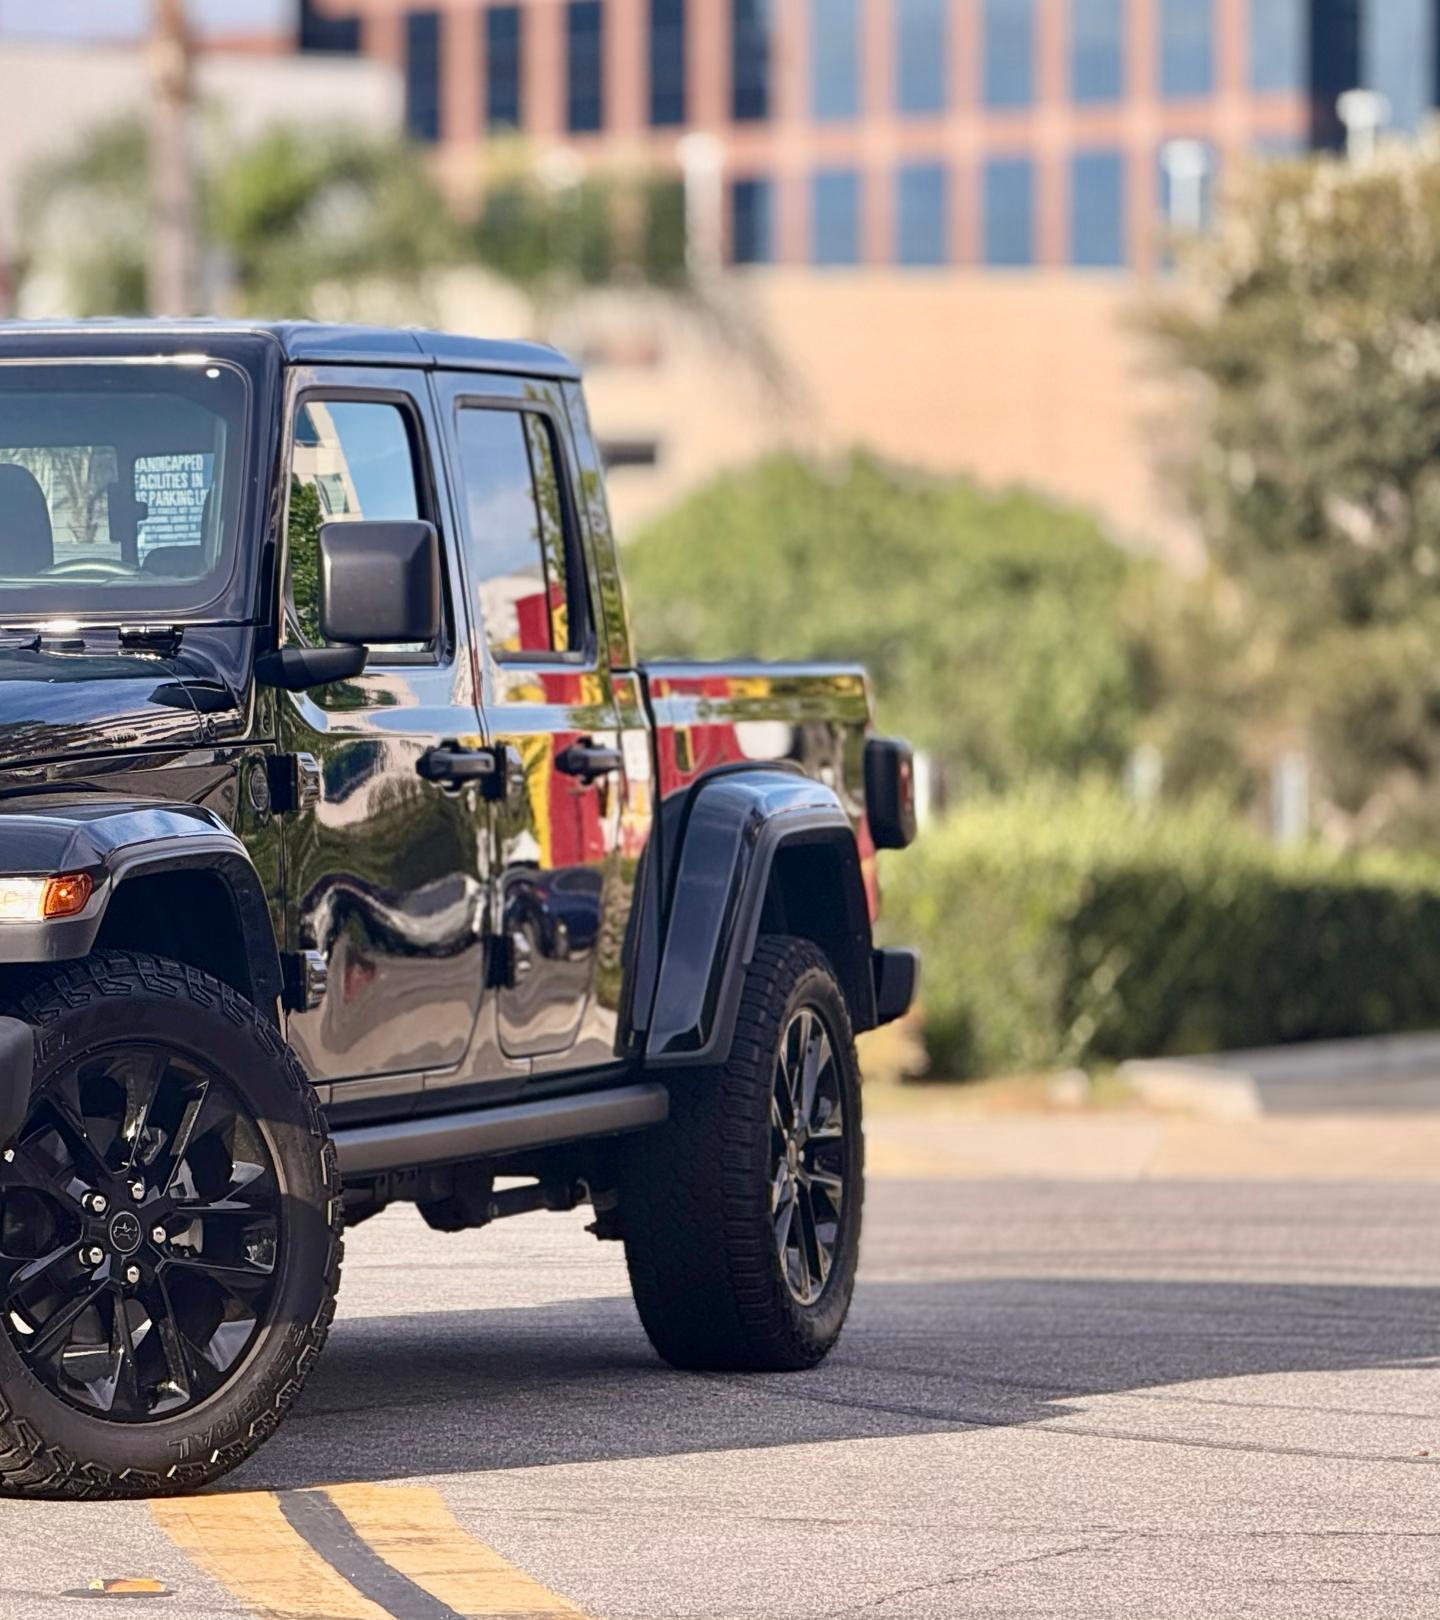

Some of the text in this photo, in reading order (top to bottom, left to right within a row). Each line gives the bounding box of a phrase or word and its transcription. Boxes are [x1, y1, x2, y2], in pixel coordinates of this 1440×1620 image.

[191, 472, 203, 489] IN
[148, 488, 194, 507] PARKING
[195, 488, 209, 506] LO
